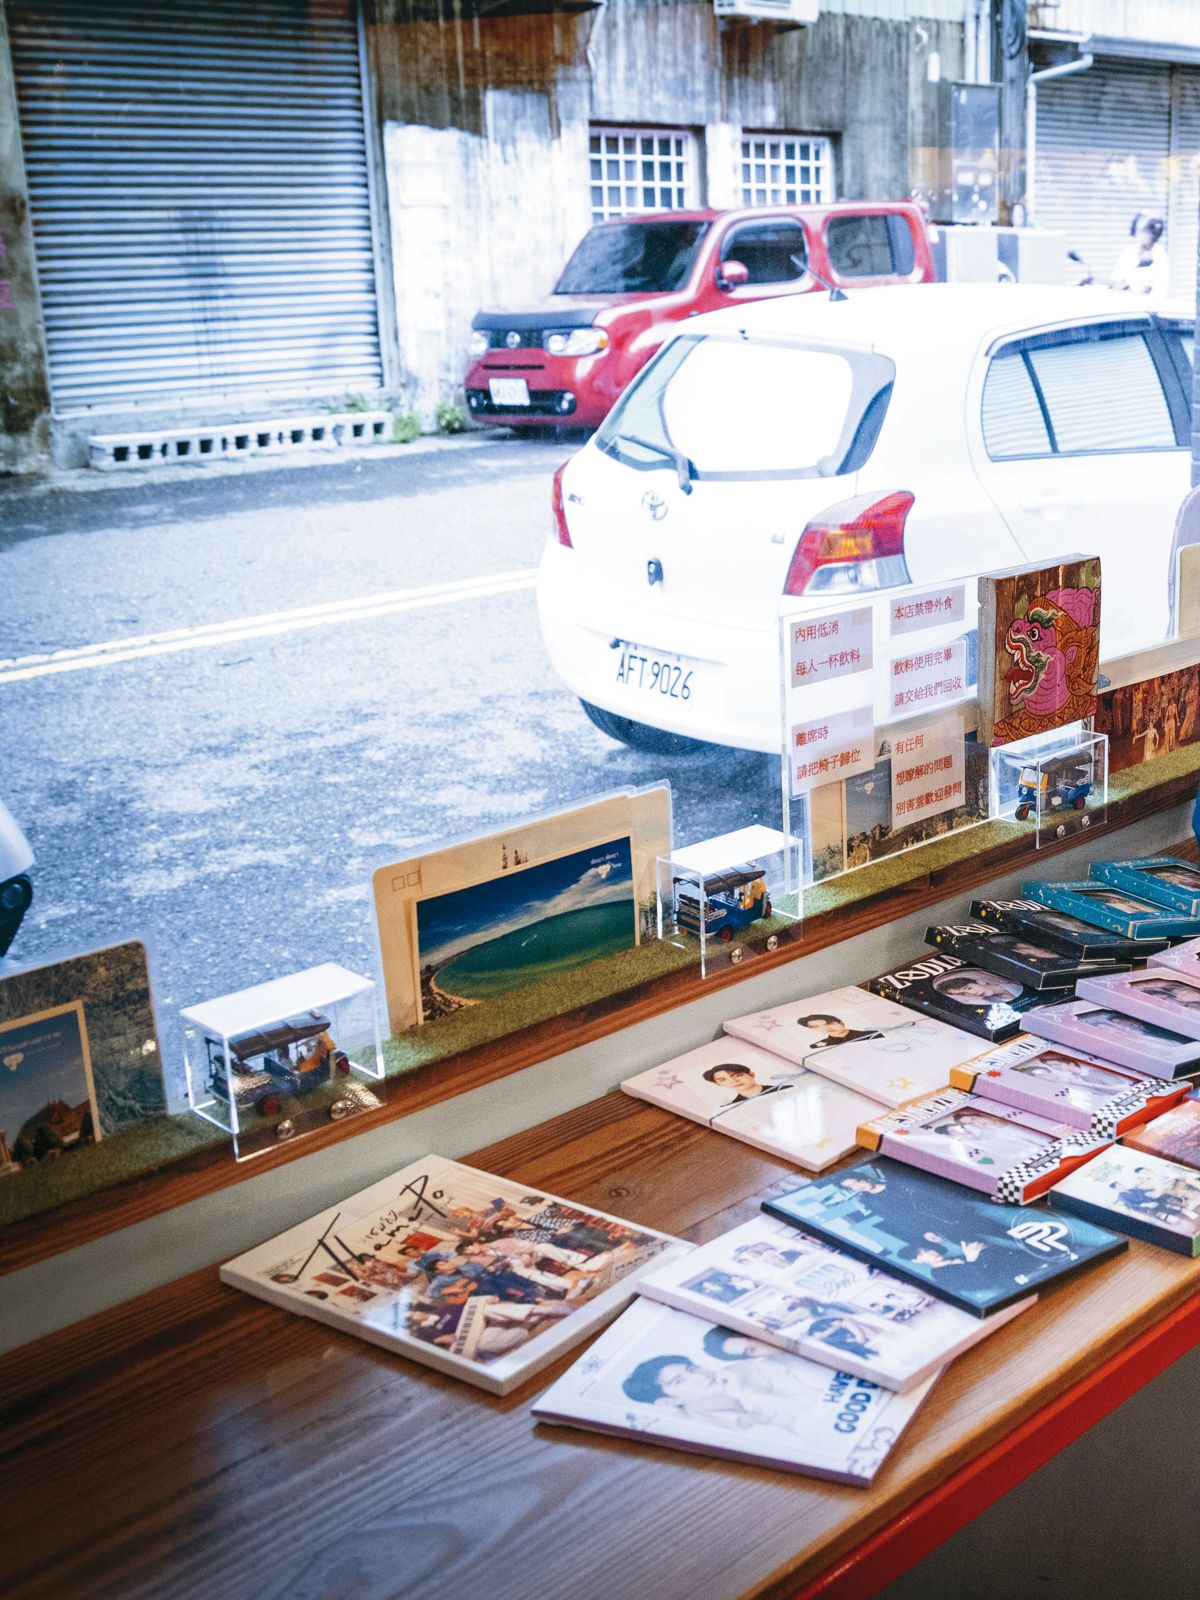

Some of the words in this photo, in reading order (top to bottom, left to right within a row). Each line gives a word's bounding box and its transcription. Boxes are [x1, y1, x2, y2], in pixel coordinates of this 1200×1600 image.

[894, 596, 953, 621] 本店禁帶外食
[795, 620, 839, 644] 內用低消
[795, 648, 861, 676] 每人一杯飲料
[894, 648, 953, 676] 飲料使用完畢
[894, 676, 962, 707] 請交給我們回收
[894, 734, 925, 756] 有任何
[797, 749, 861, 780] 請把椅子歸位
[878, 954, 968, 990] ZODIA
